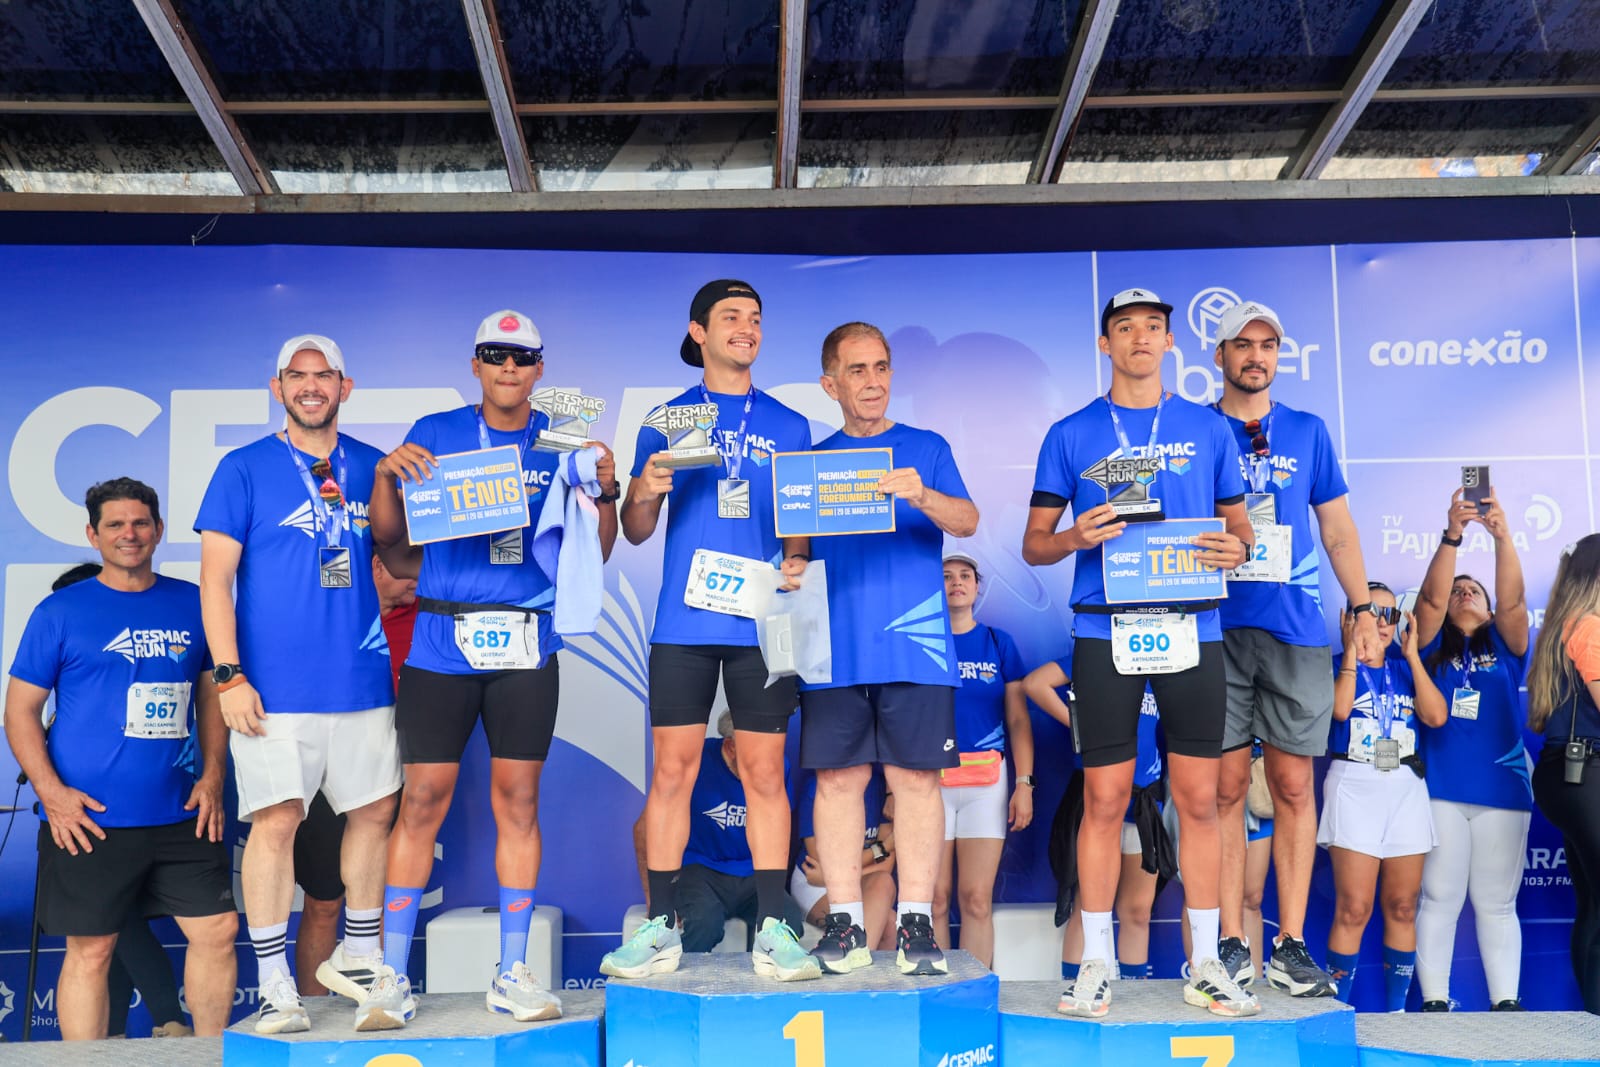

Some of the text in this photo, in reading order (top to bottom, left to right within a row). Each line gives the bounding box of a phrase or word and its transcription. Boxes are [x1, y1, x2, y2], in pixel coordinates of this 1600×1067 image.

[1369, 330, 1548, 366] conexão
[556, 393, 604, 411] CESMAC
[554, 403, 579, 416] RUN
[668, 406, 716, 418] CESMAC
[669, 417, 694, 429] RUN
[1108, 459, 1159, 472] CESMAC
[444, 466, 485, 481] PREMIAÇÃO
[818, 470, 857, 481] PREMIAÇÃO
[1108, 470, 1135, 482] RUN
[447, 477, 520, 511] TÊNIS
[818, 482, 853, 493] RELÓGIO
[819, 492, 873, 504] FORERUNNER
[1381, 515, 1404, 526] TV
[1147, 535, 1188, 546] PREMIAÇÃO
[705, 571, 745, 595] 677
[132, 629, 192, 645] CESMAC
[472, 630, 512, 649] 687
[1128, 633, 1170, 653] 690
[134, 642, 166, 658] RUN
[957, 661, 998, 674] ESMAC
[145, 701, 178, 719] 967
[1524, 876, 1554, 887] 103,7
[782, 1010, 826, 1067] 1
[949, 1044, 995, 1067] CESMAC
